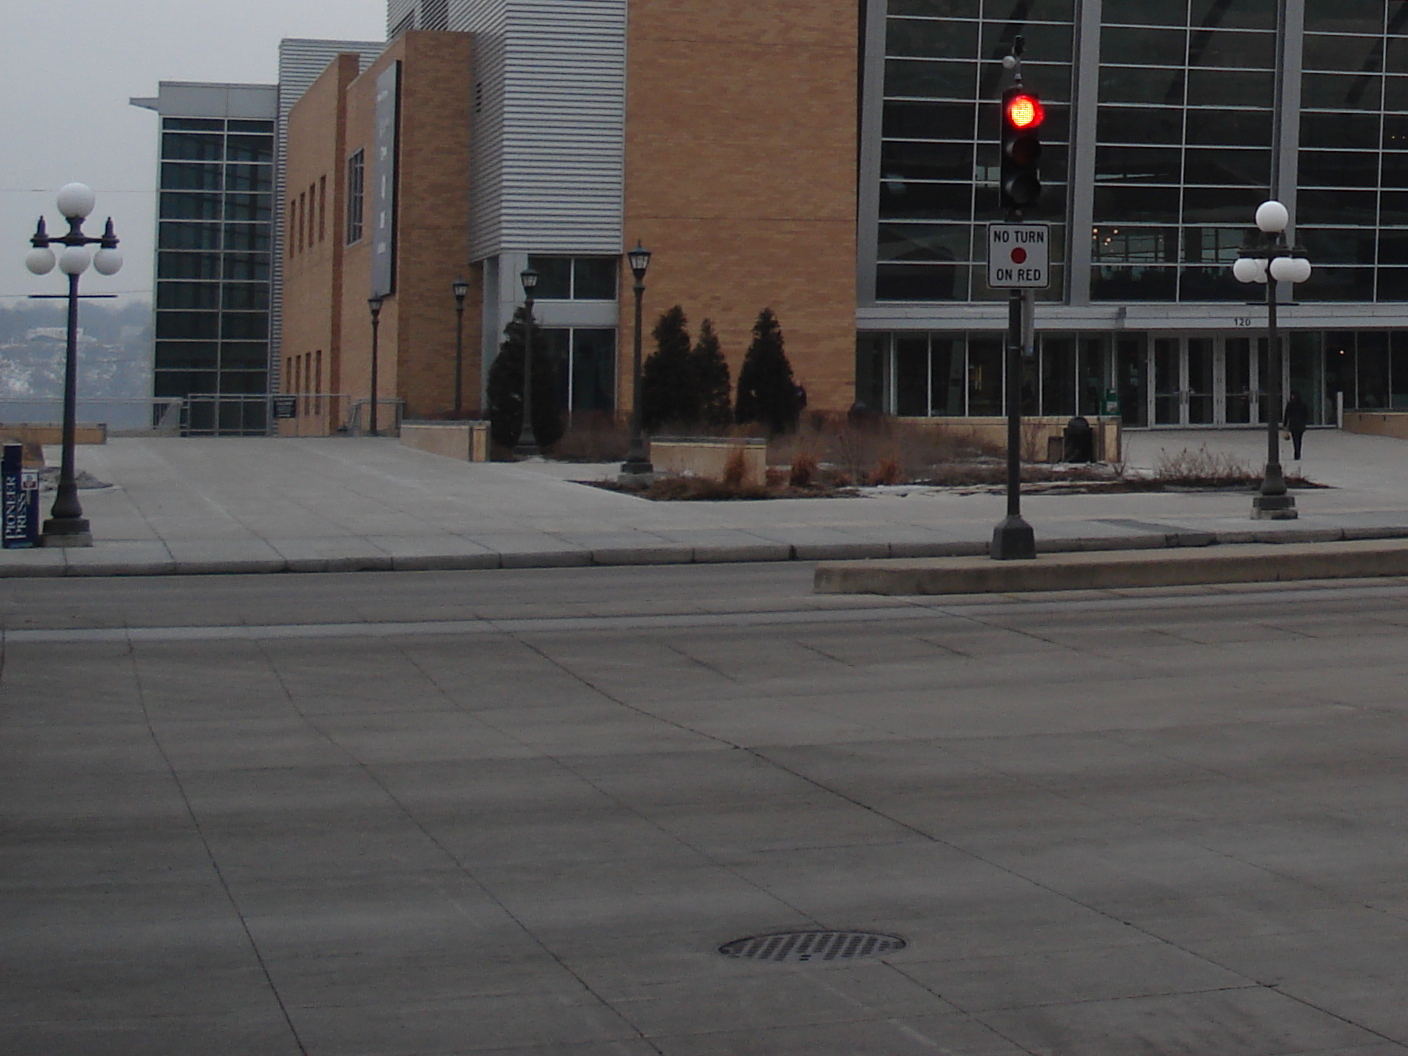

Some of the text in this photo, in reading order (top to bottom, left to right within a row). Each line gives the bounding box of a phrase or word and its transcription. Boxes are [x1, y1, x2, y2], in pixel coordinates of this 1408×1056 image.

[993, 230, 1044, 243] NO TURN
[996, 268, 1041, 281] ON RED
[1234, 318, 1251, 327] 120
[5, 476, 16, 539] PIONEER
